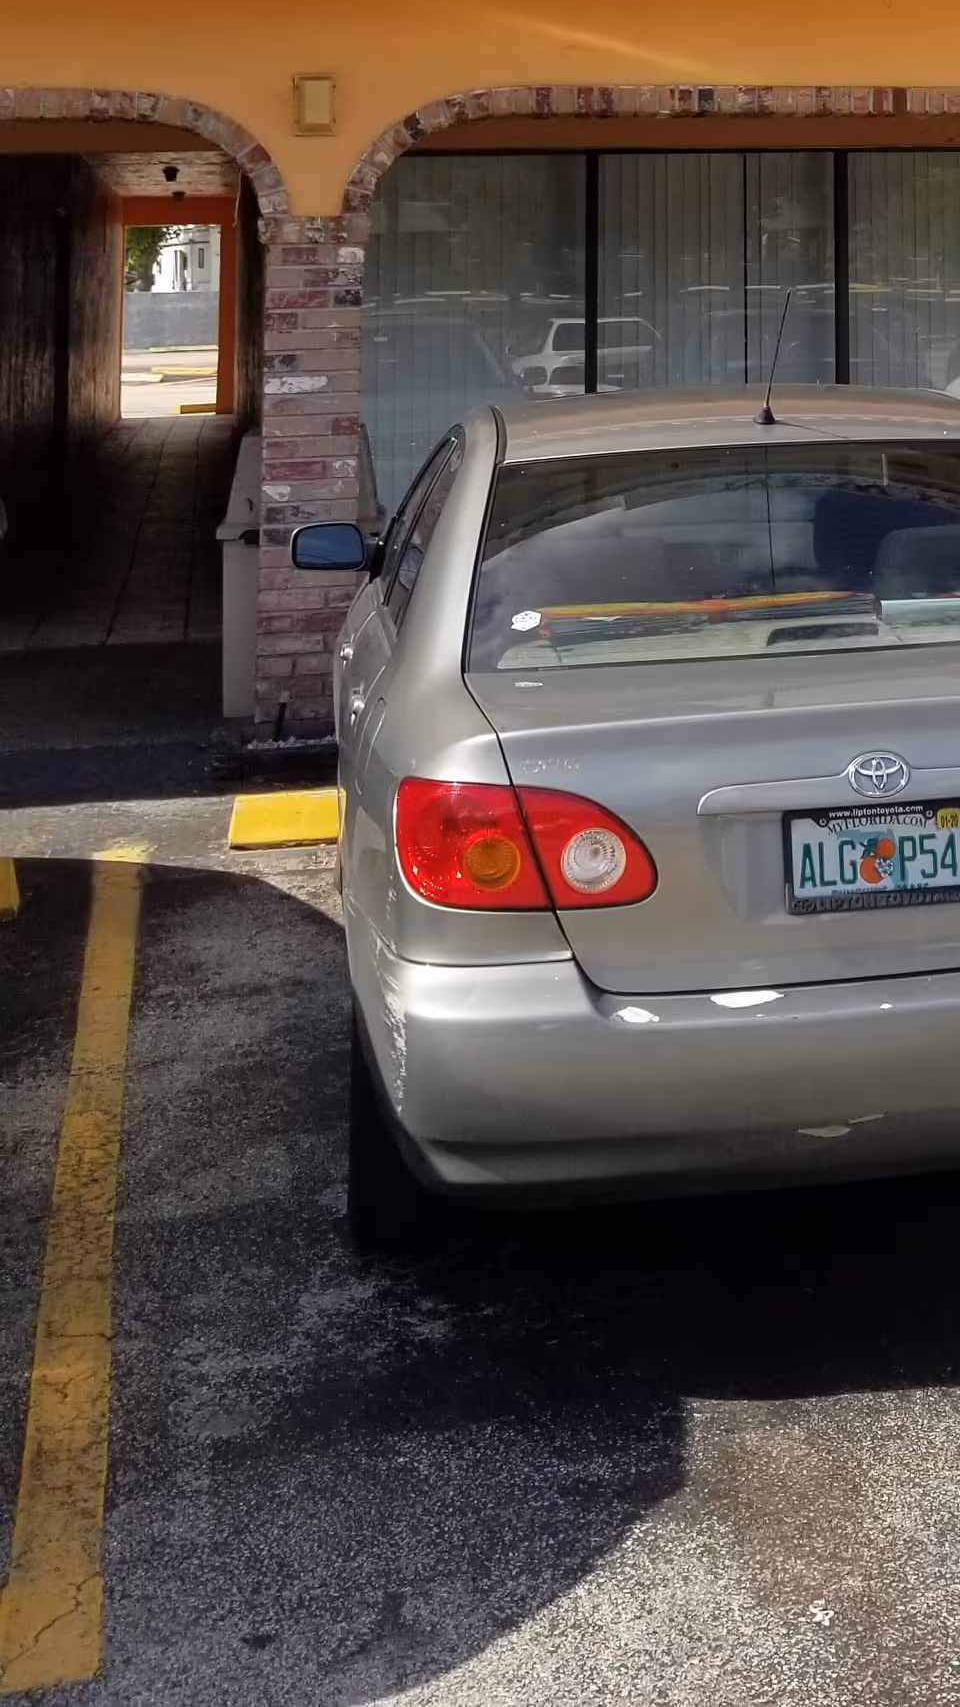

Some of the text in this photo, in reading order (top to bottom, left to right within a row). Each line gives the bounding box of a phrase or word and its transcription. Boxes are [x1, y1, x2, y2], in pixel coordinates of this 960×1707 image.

[828, 805, 924, 818] www.liptontoyota.com
[827, 814, 959, 836] MYFLORIDA.COM 01-20
[799, 830, 958, 889] ALG P54
